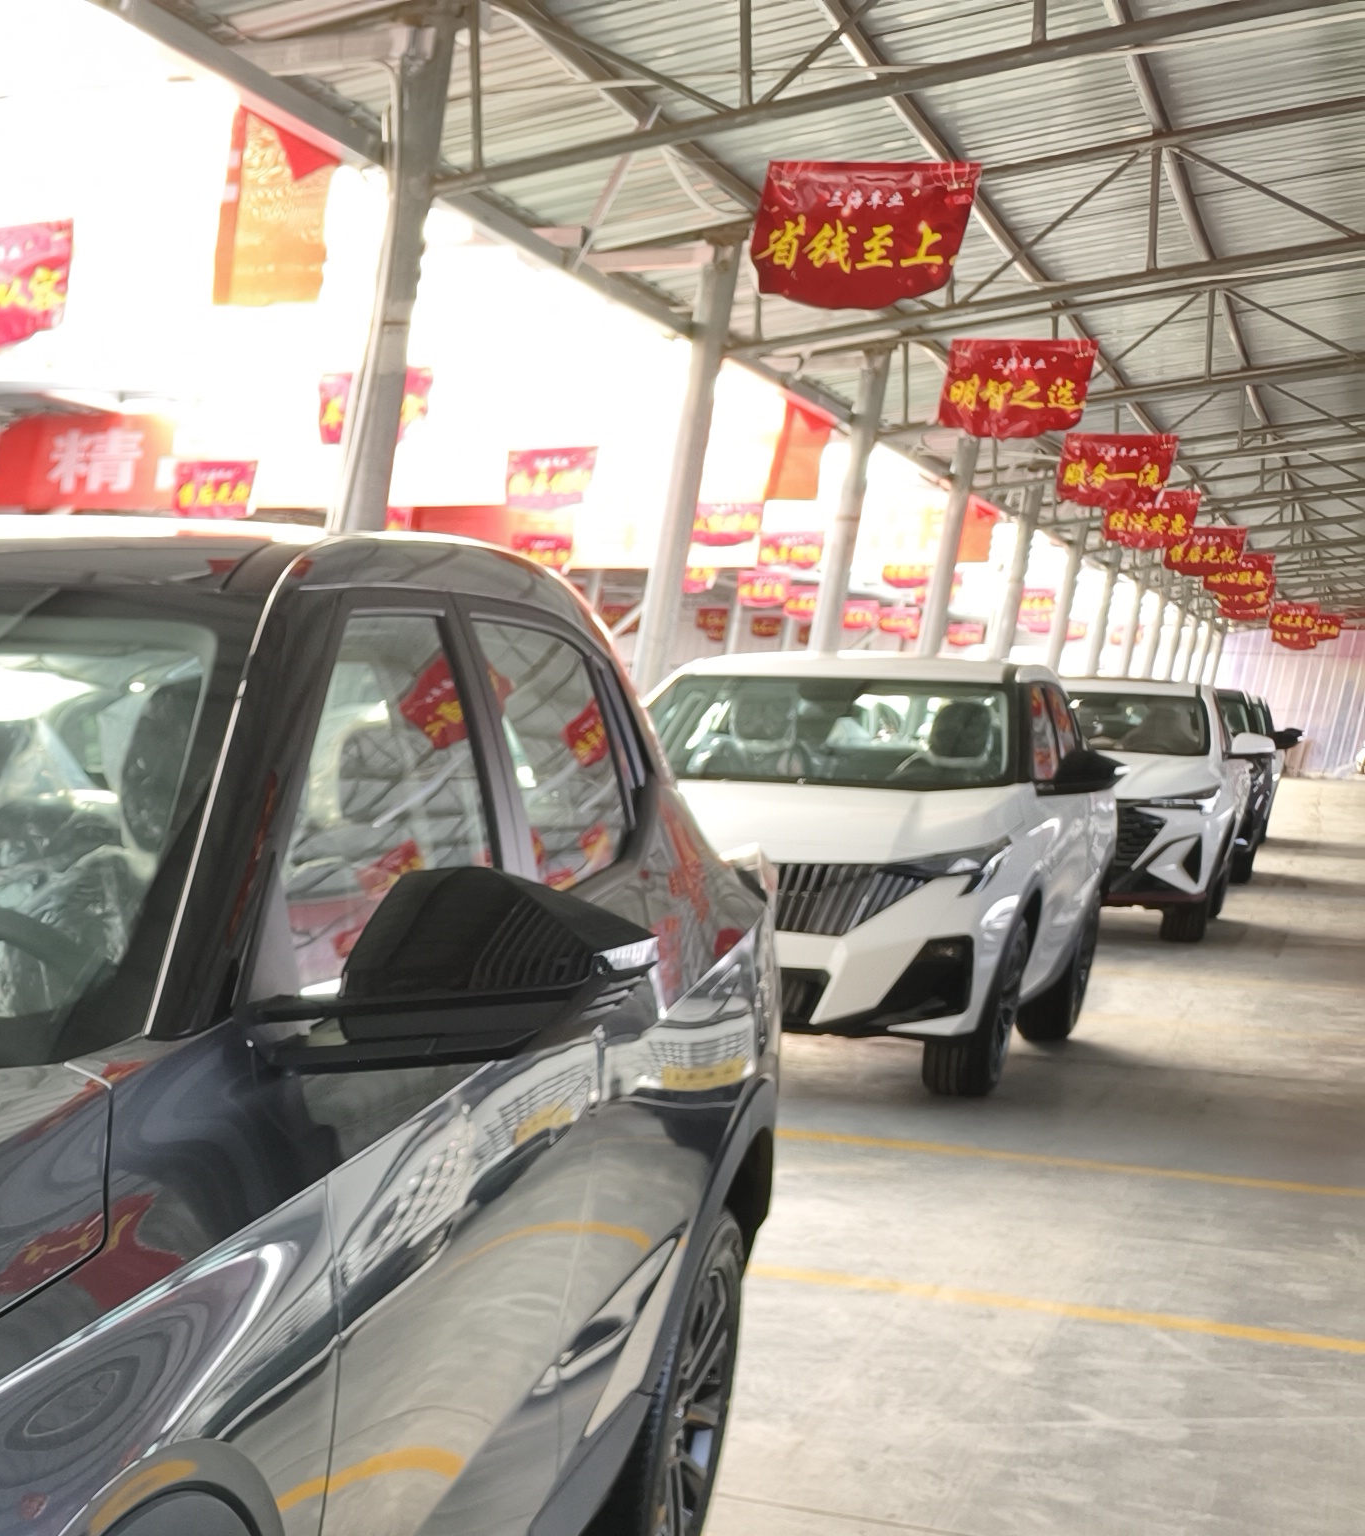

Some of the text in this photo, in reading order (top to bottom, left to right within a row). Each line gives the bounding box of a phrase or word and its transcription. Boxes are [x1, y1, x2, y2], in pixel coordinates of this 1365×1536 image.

[754, 213, 945, 275] 省钱至上
[949, 373, 1082, 413] 明智之选
